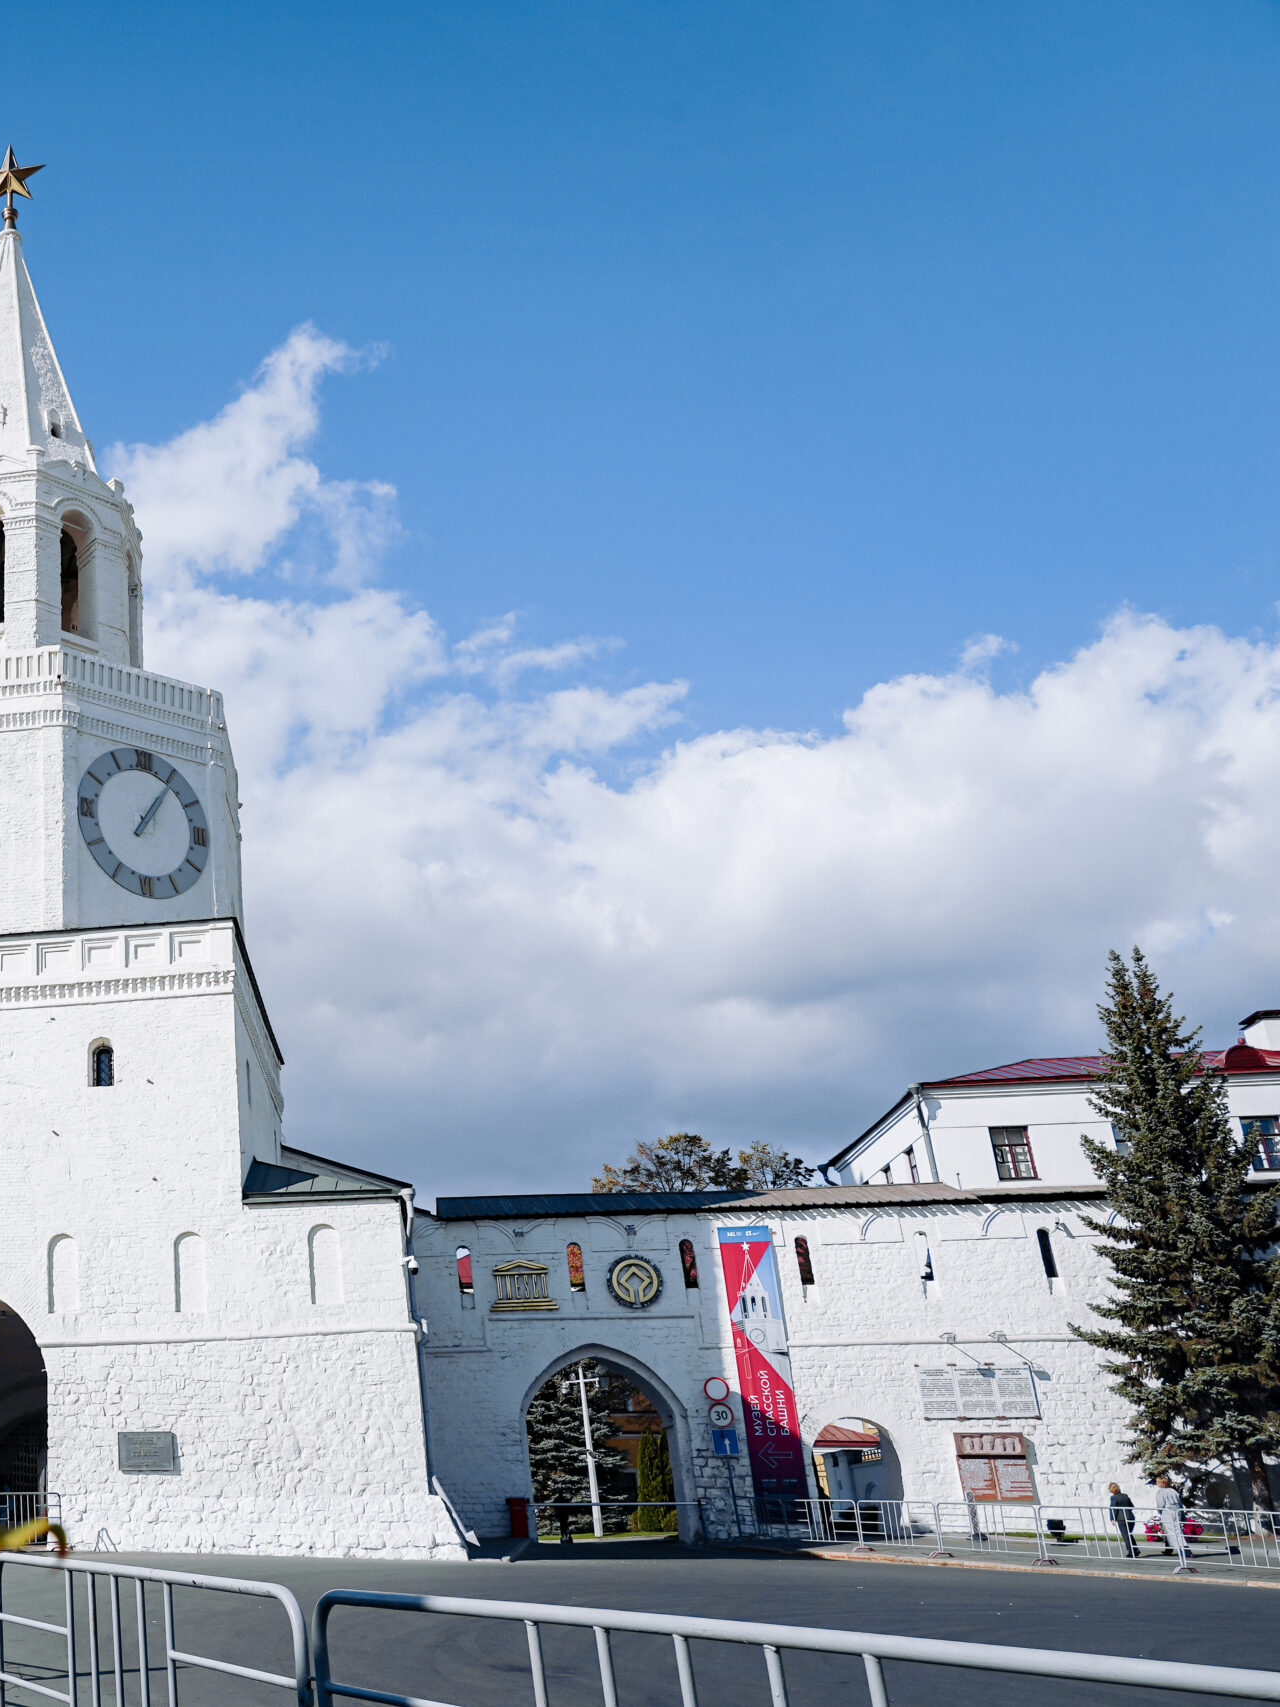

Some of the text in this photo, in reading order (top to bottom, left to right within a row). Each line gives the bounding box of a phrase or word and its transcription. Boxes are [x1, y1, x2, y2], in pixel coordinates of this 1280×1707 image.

[135, 749, 153, 771] XII
[81, 796, 95, 818] IX
[193, 826, 207, 847] III
[139, 875, 153, 896] VI
[496, 1274, 548, 1299] UNESCO
[757, 1370, 777, 1436] СПАССКОЙ
[775, 1390, 790, 1436] БАШНИ
[714, 1410, 728, 1421] 30
[748, 1395, 763, 1436] МУЗЕЙ
